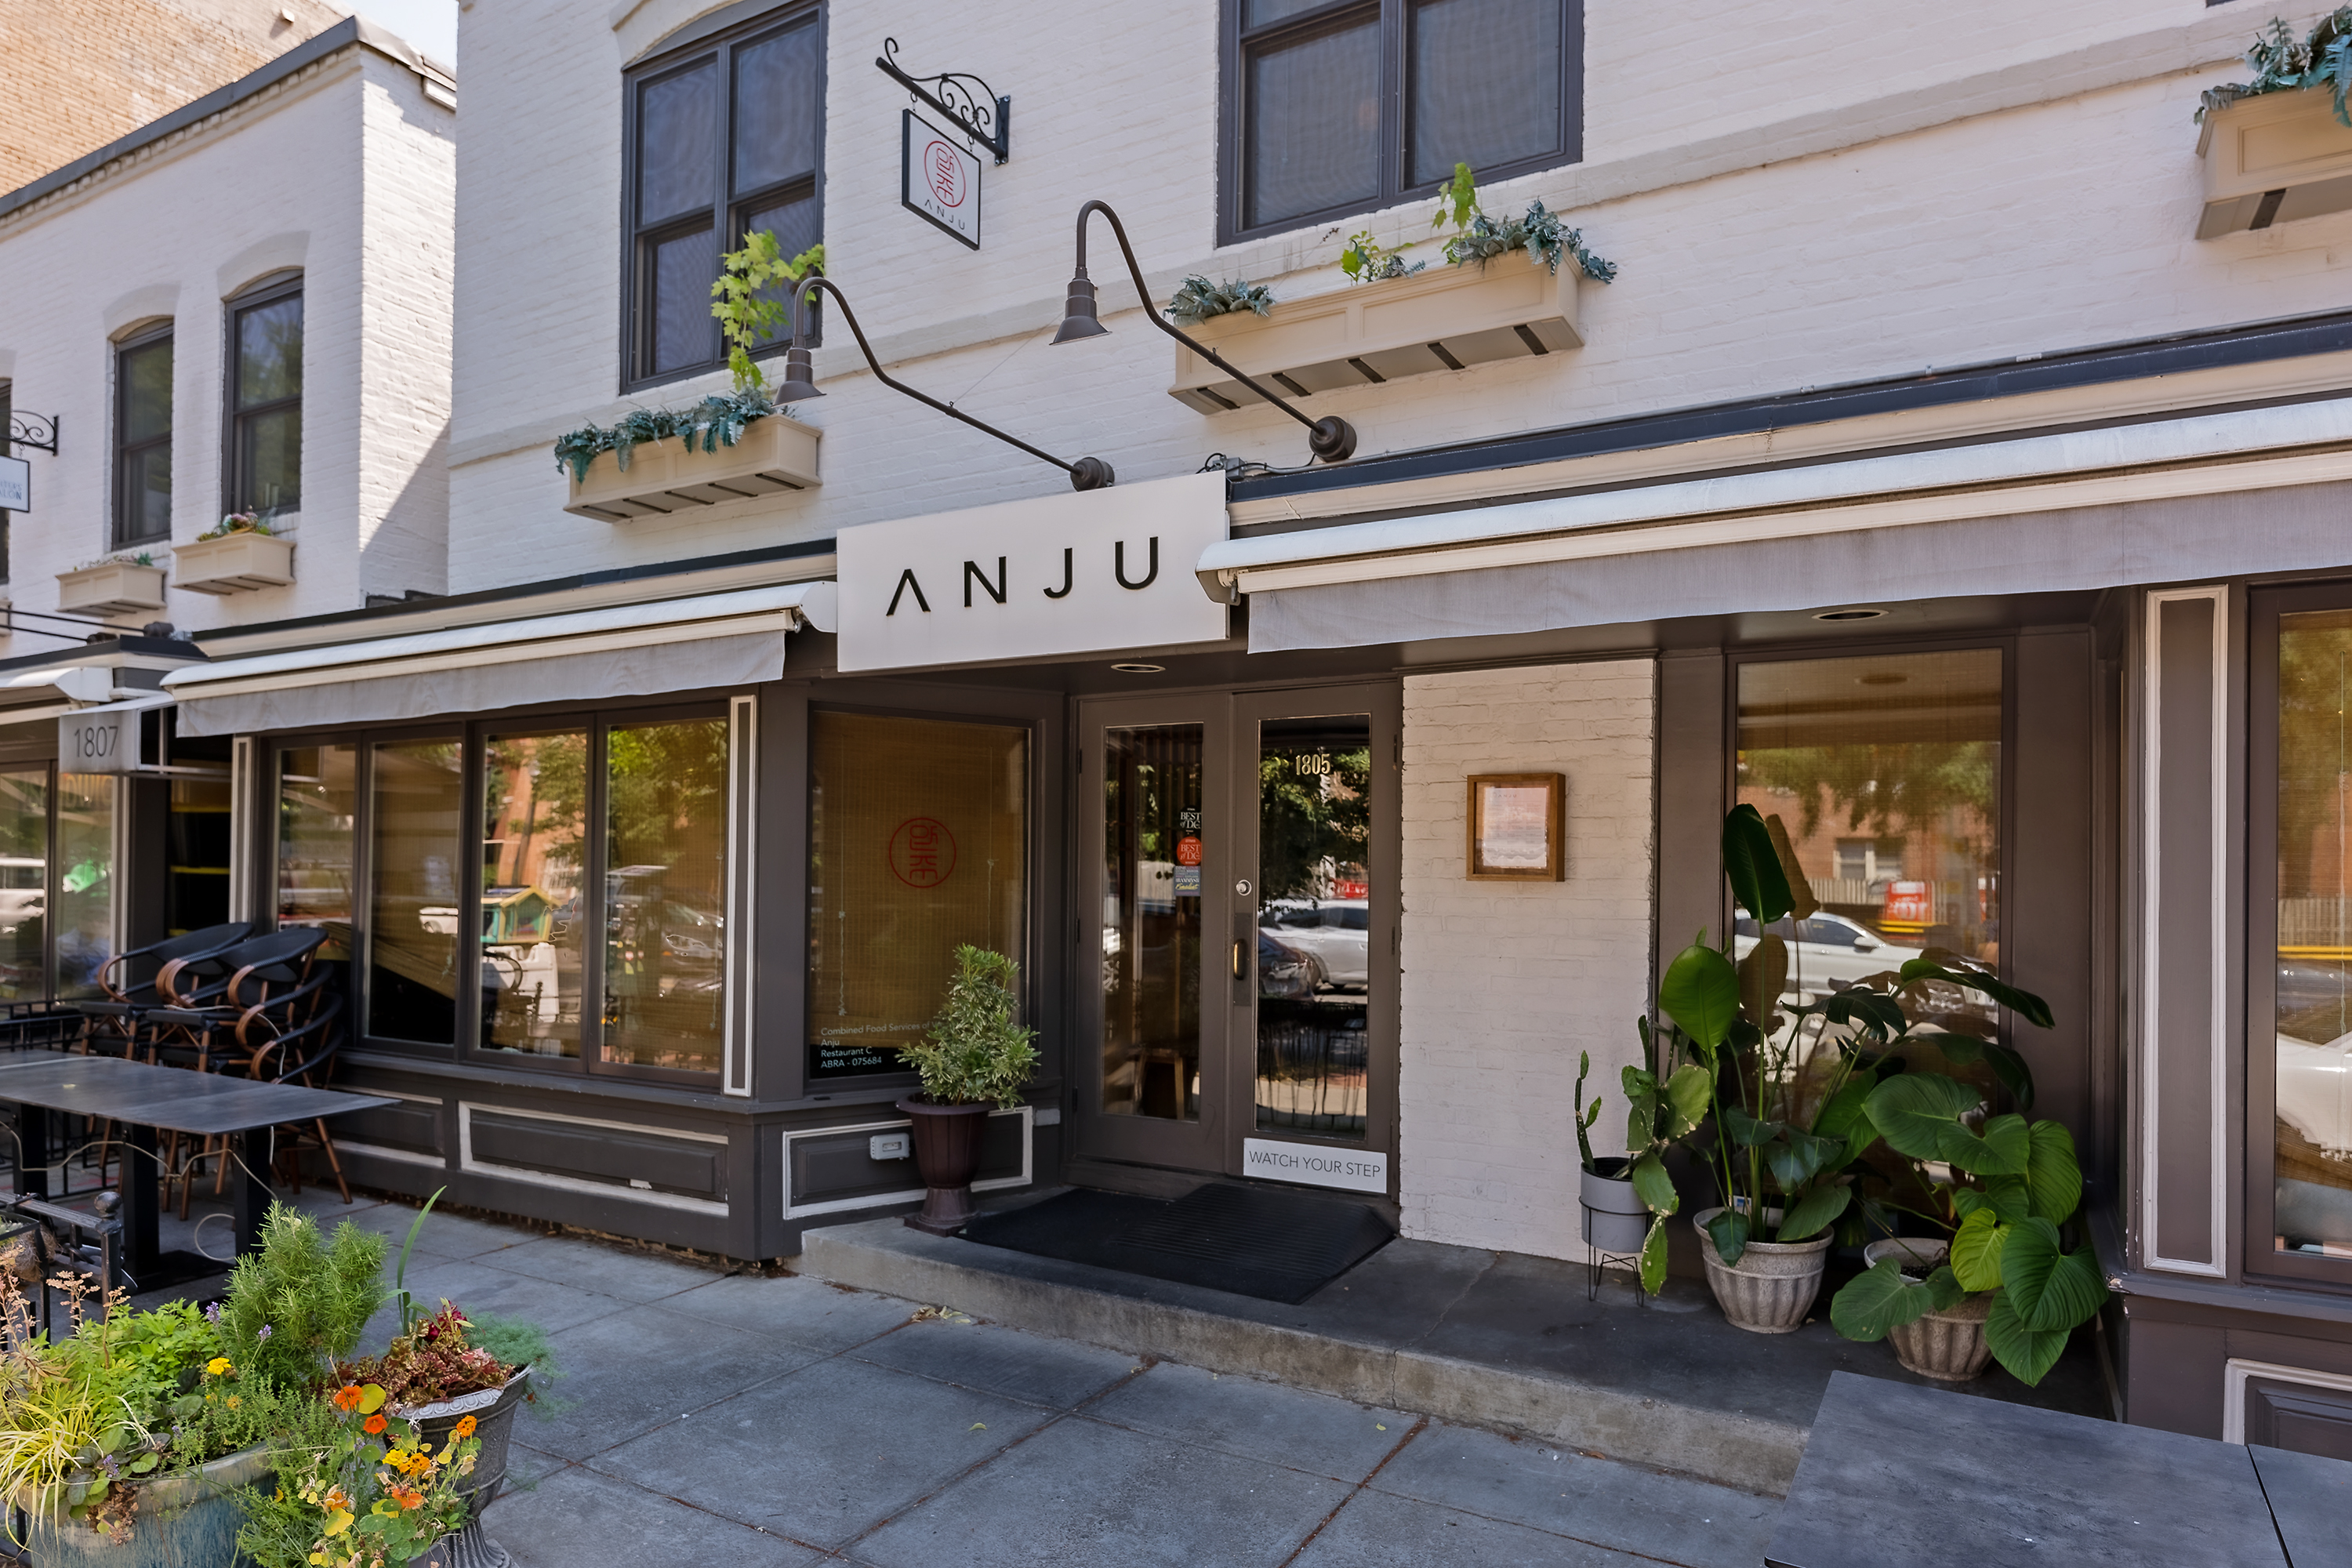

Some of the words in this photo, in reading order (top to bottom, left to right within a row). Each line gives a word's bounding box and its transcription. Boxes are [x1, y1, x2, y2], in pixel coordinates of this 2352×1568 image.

[924, 199, 965, 230] ANJU
[886, 536, 1159, 616] ANJU
[74, 726, 118, 757] 1807
[1296, 753, 1330, 775] 1805
[821, 1025, 863, 1036] Combined
[866, 1024, 887, 1033] Food
[889, 1022, 920, 1032] Services
[821, 1038, 840, 1048] Anju
[821, 1048, 864, 1058] Restaurant
[821, 1059, 845, 1069] ABRA
[851, 1056, 882, 1067] 075684
[1249, 1150, 1298, 1168] WATCH
[1302, 1156, 1342, 1174] YOUR
[1346, 1162, 1381, 1178] STEP
